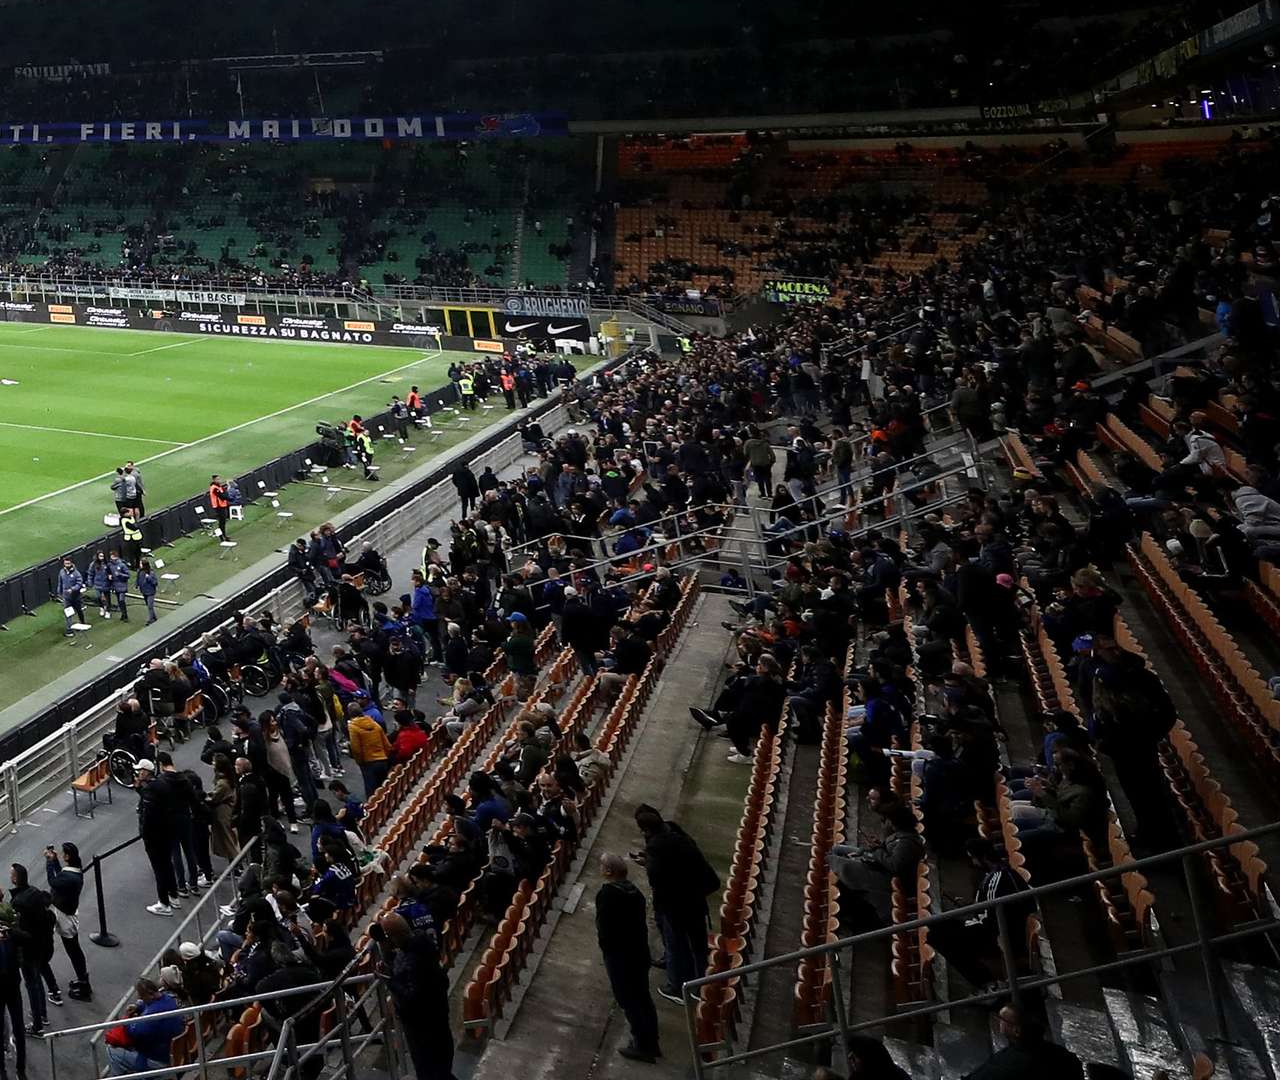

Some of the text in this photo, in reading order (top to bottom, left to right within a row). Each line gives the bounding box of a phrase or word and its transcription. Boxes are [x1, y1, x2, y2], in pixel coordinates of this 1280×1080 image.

[228, 120, 299, 139] MAI
[333, 117, 445, 138] DOMI
[776, 281, 830, 295] MODENA
[660, 302, 704, 314] EGNANO
[199, 323, 277, 336] SICUREZZA
[281, 328, 295, 338] SU
[301, 329, 373, 342] BAGNATO
